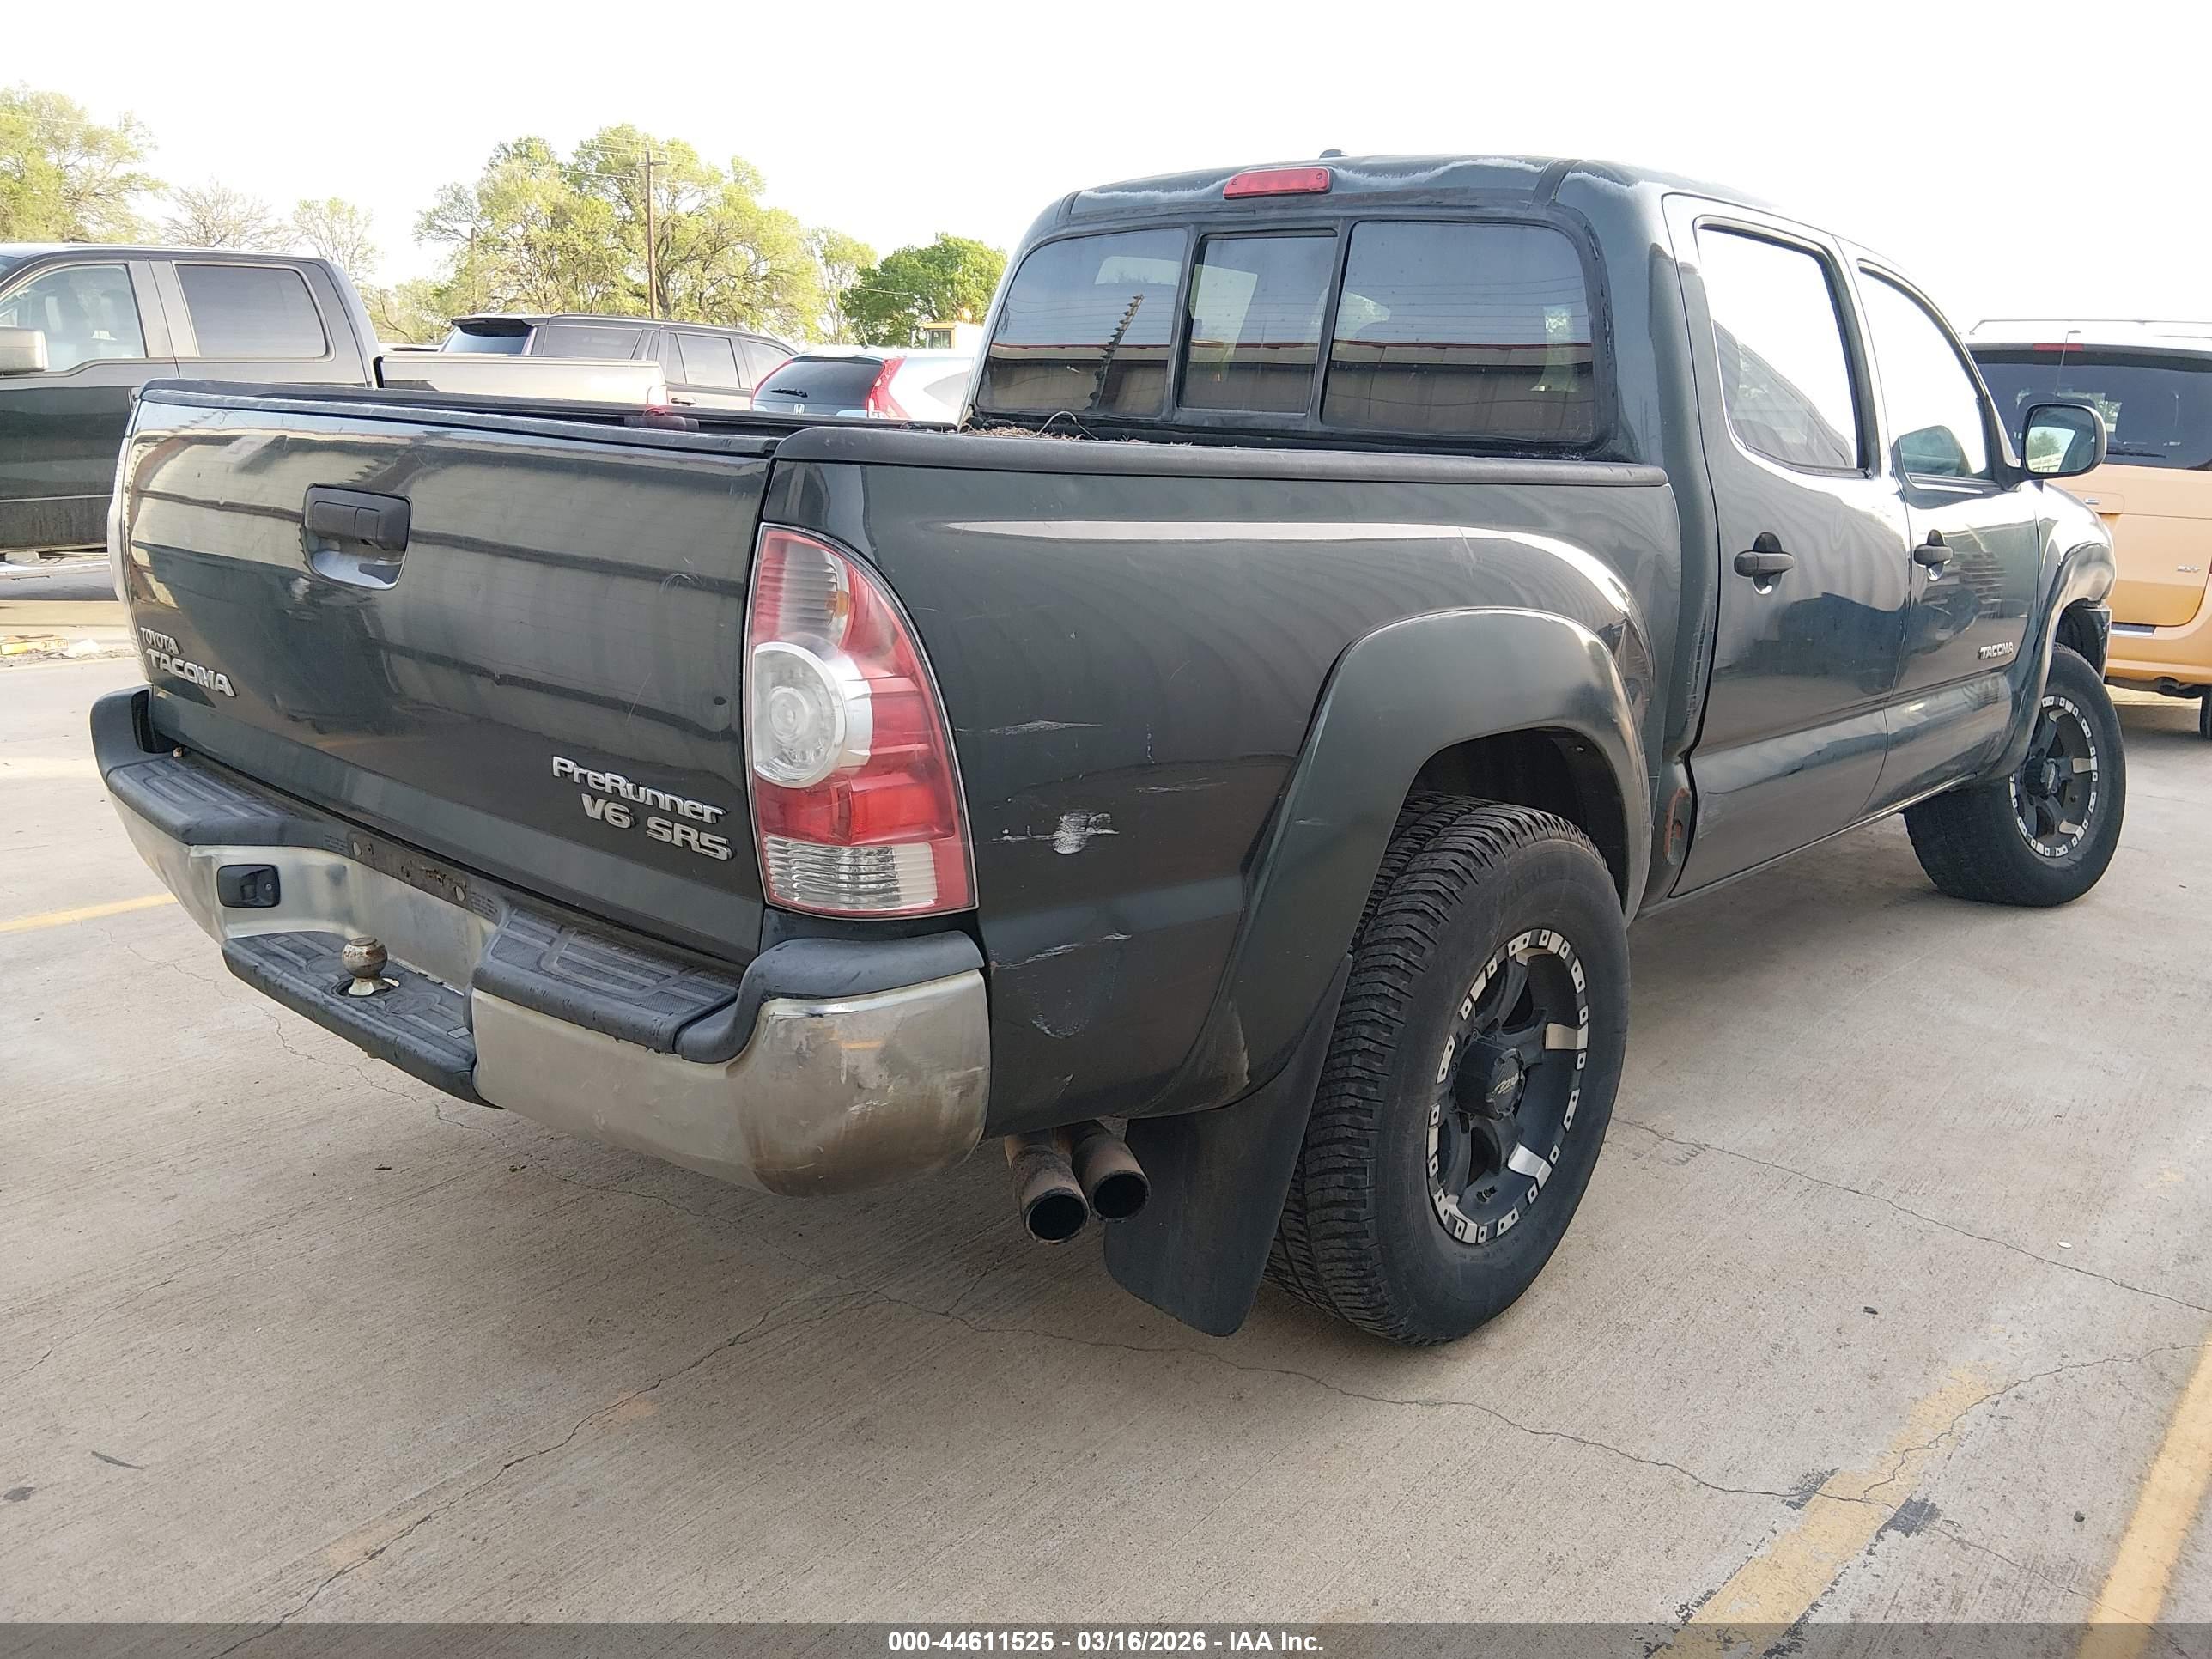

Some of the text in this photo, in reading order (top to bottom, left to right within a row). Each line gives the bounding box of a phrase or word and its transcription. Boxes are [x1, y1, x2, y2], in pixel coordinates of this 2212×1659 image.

[140, 627, 182, 654] TOYOTA
[1978, 641, 2014, 659] TACOMA
[146, 647, 236, 697] TACOMA
[552, 755, 727, 824] PreRunner
[580, 793, 734, 861] V6 SR5
